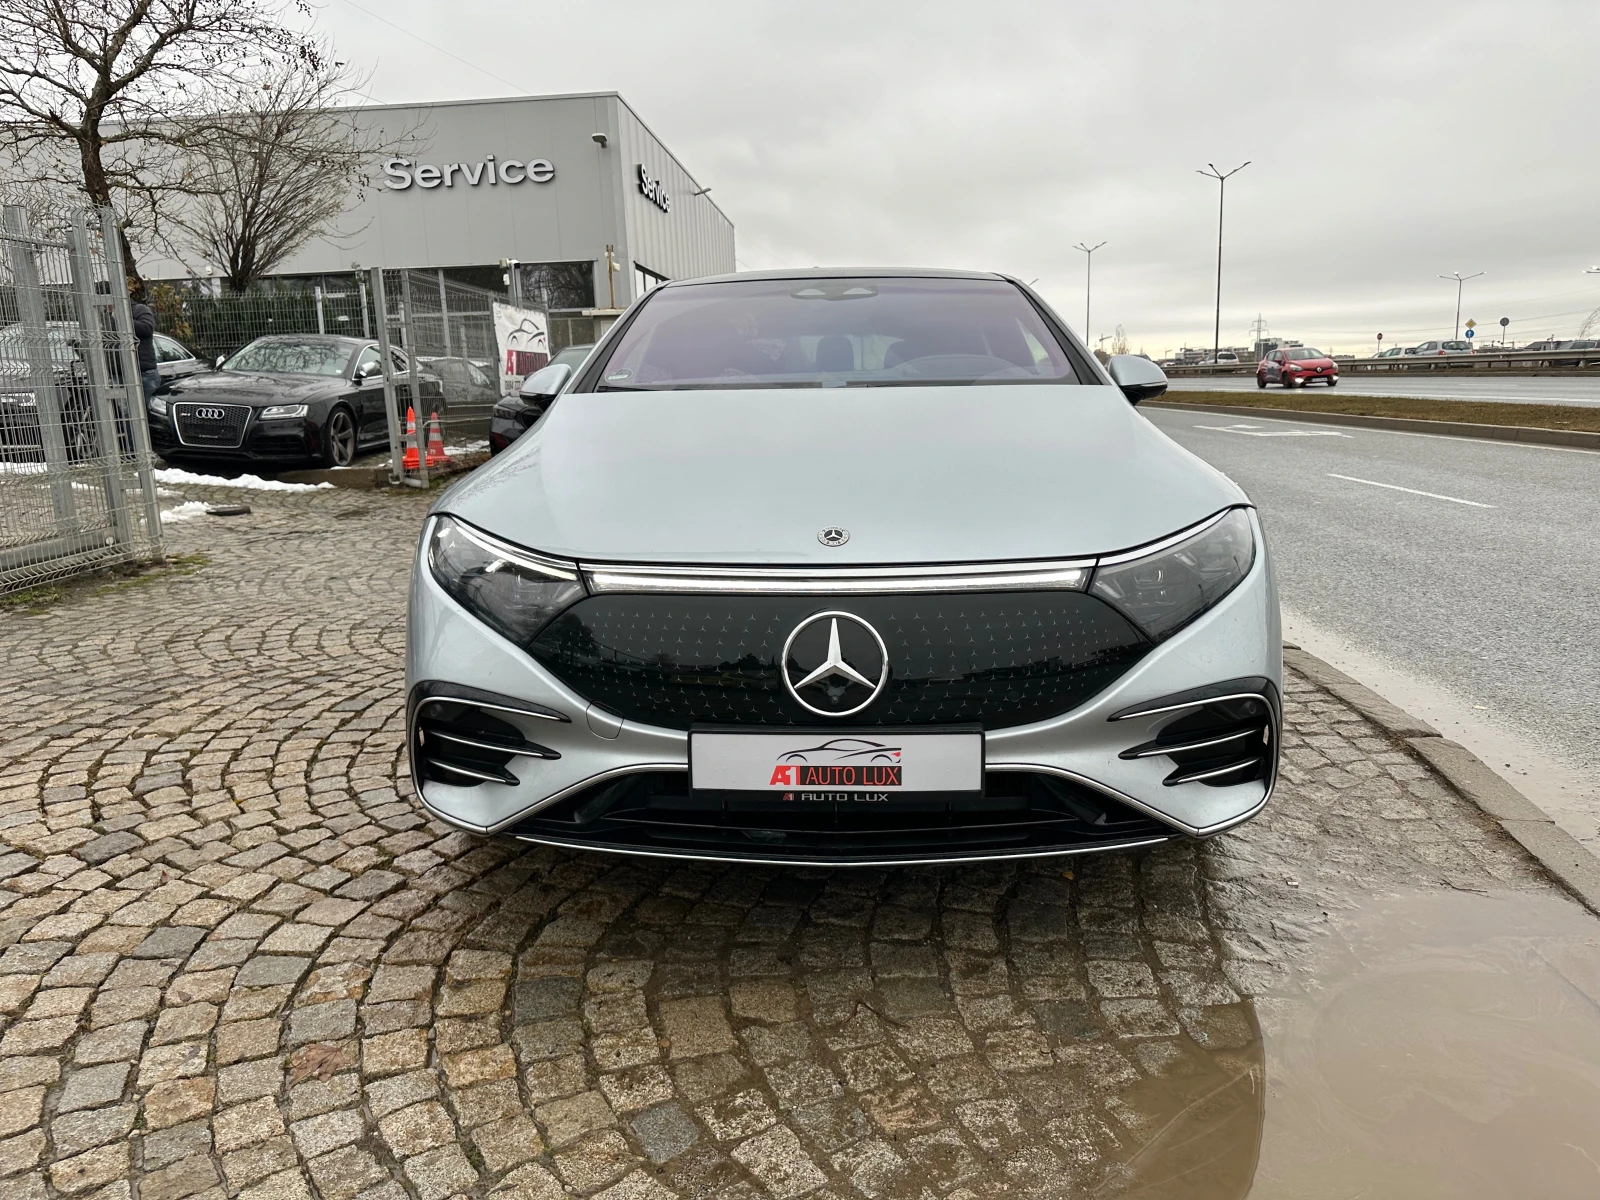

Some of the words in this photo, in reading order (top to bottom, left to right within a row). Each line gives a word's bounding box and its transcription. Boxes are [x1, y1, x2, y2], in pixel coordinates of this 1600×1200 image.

[383, 154, 555, 190] Service
[640, 164, 671, 213] Service
[770, 765, 800, 785] A1
[805, 766, 856, 785] AUTO
[863, 766, 899, 785] LUX
[783, 793, 794, 801] A1
[801, 793, 847, 801] AUTO
[854, 793, 888, 802] LUX
